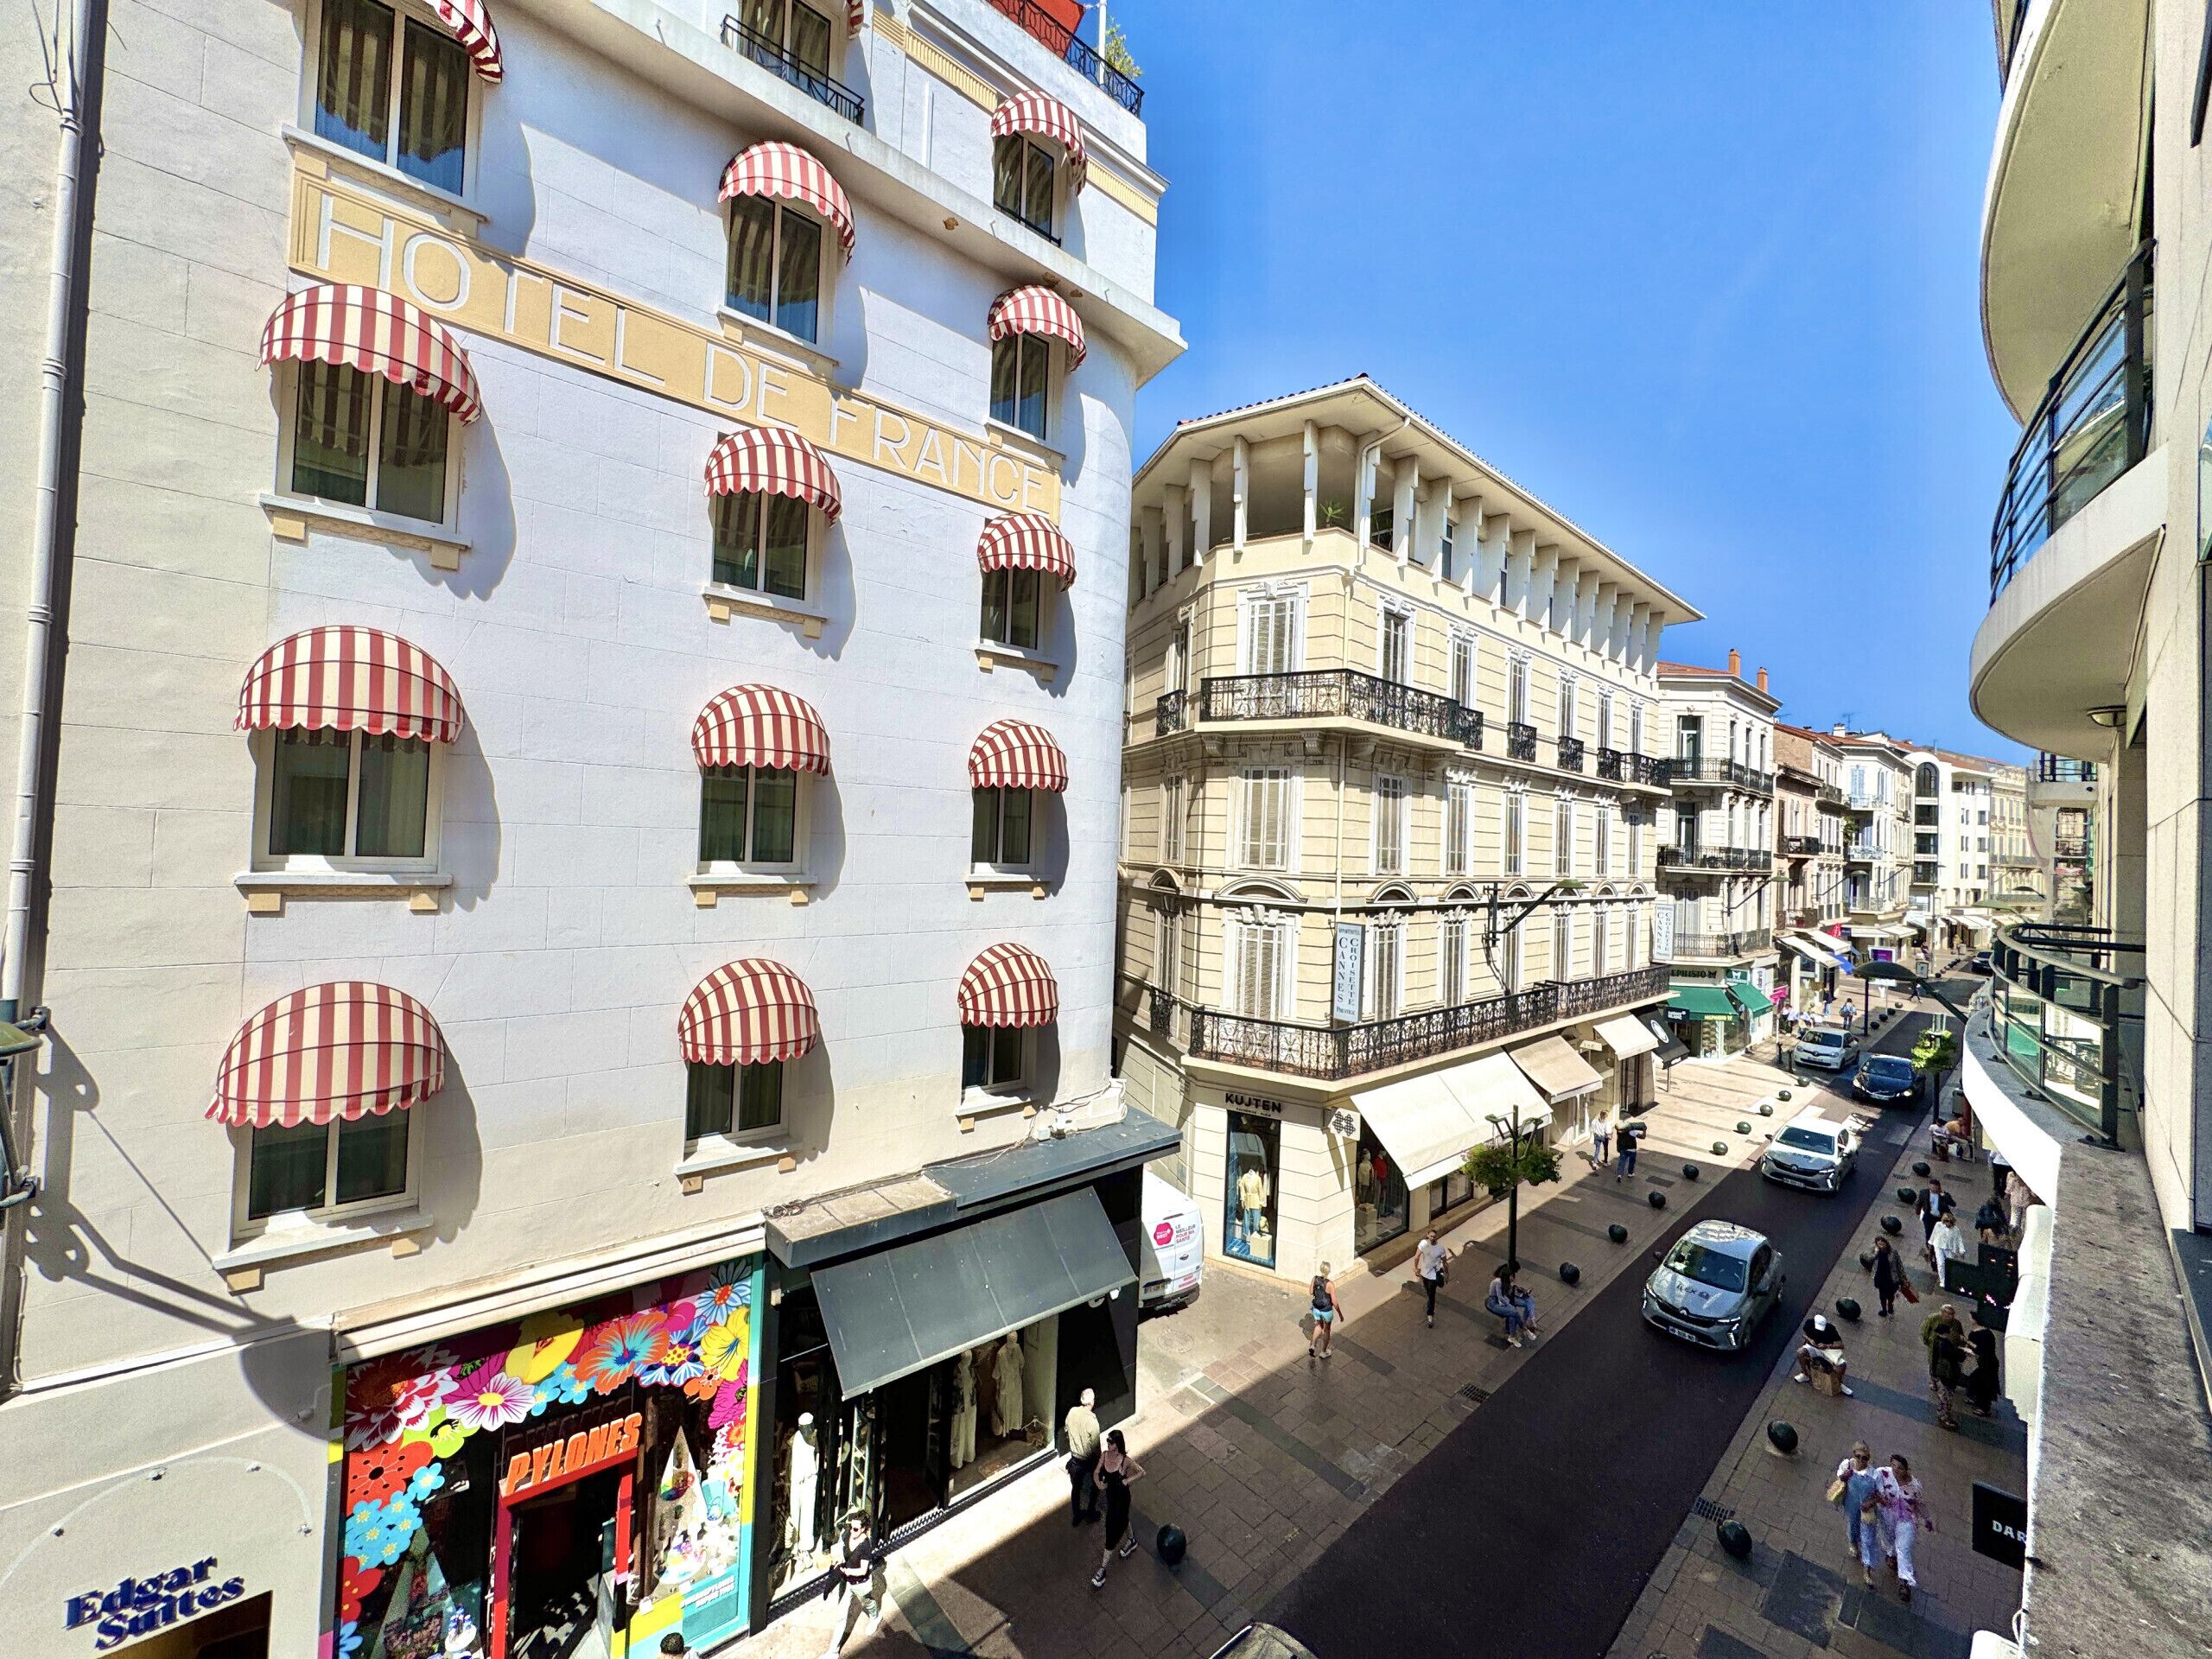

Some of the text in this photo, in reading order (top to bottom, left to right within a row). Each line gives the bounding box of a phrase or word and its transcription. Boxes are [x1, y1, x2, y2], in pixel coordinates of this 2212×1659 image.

[318, 193, 1049, 518] HOTEL DE FRANCE
[1337, 937, 1348, 1003] CANNES
[1348, 938, 1359, 1006] CROISETTE
[1671, 969, 1707, 978] EPHISTO
[1225, 1092, 1281, 1113] KUJTEN
[505, 1413, 643, 1496] PYLONES
[62, 1556, 218, 1630] Edgar
[94, 1576, 245, 1650] Suites
